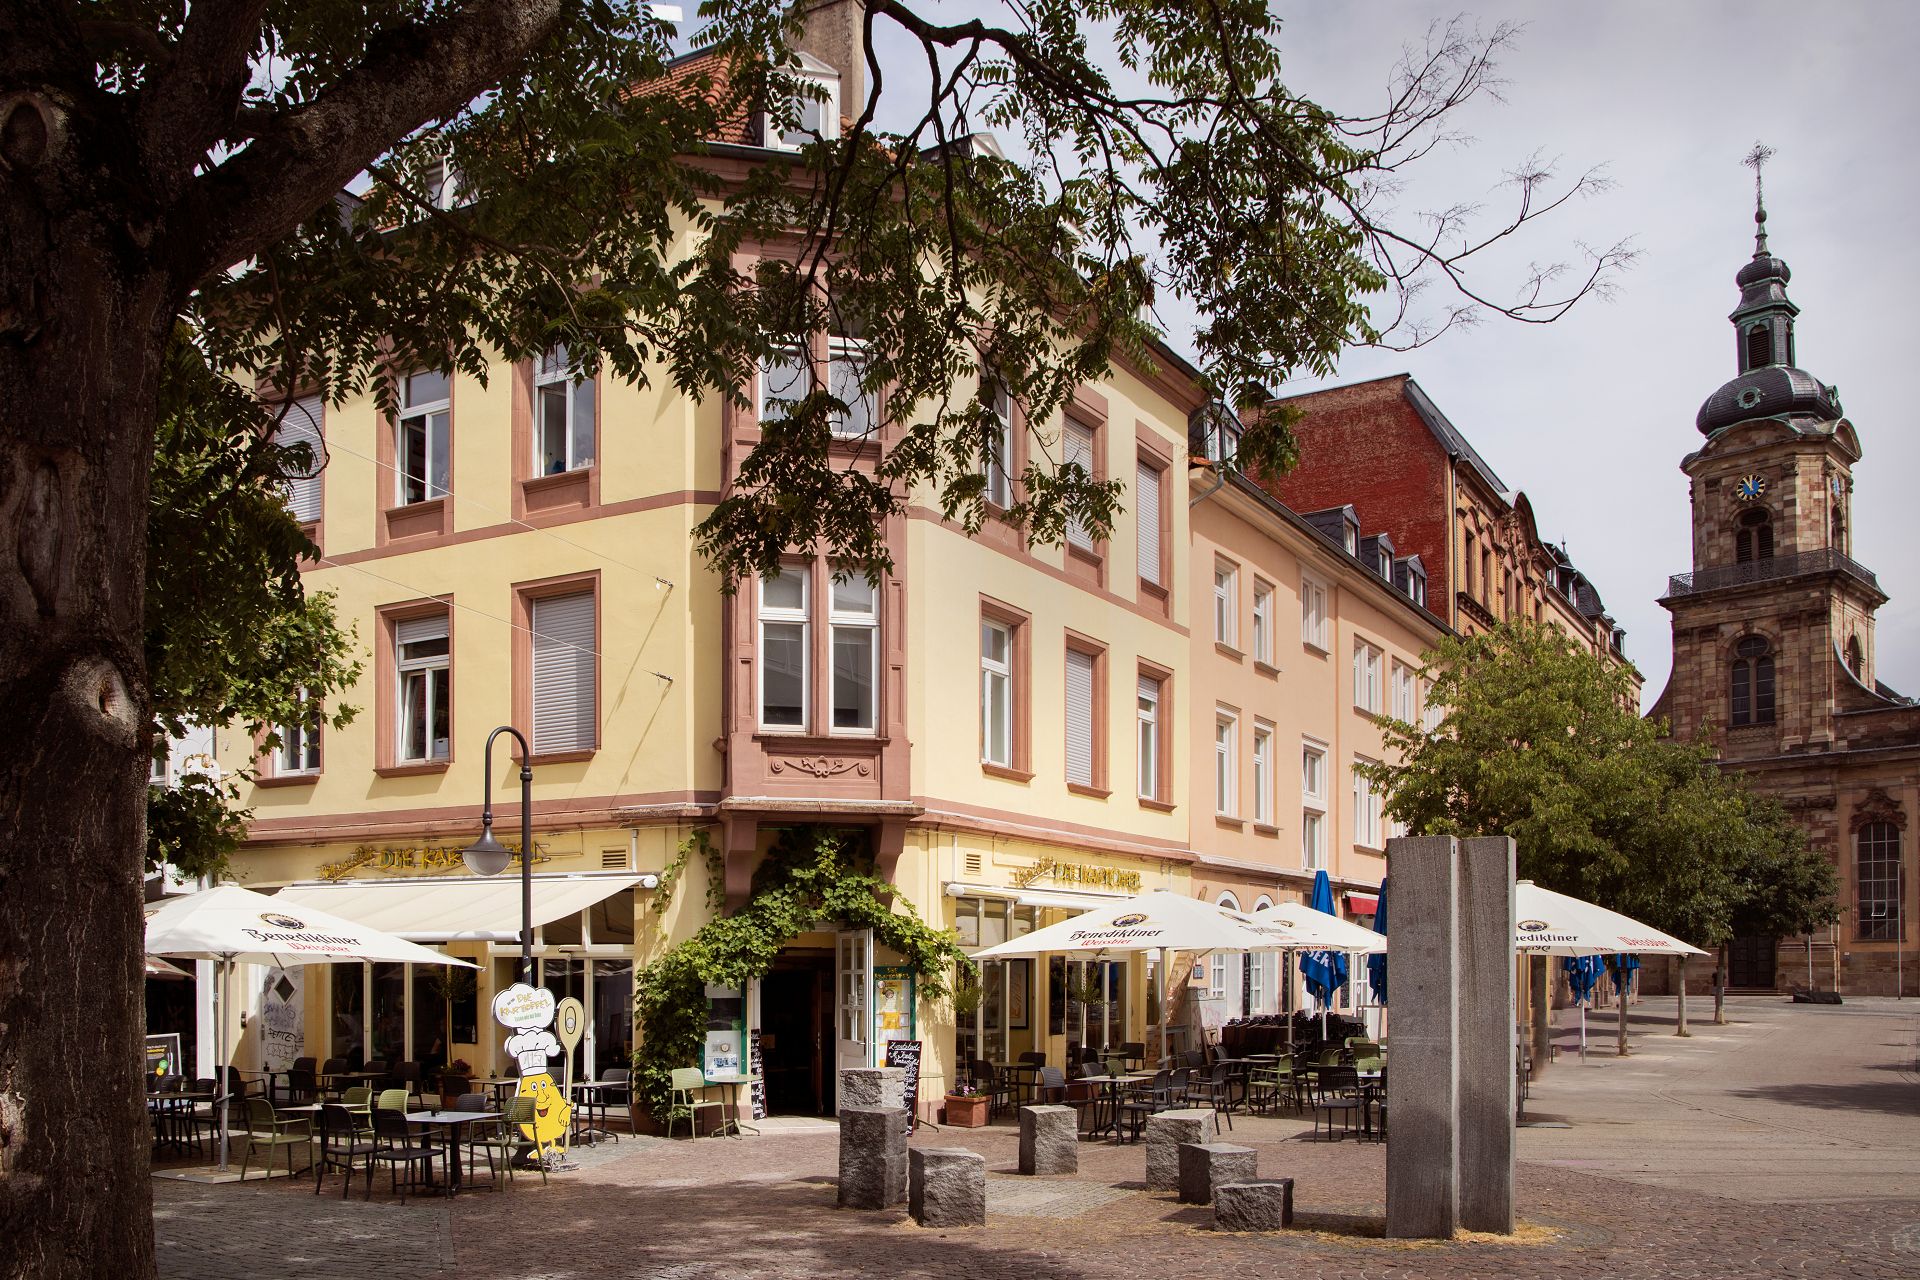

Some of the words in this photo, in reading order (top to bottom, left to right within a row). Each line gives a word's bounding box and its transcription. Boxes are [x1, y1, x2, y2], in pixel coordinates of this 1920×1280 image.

[379, 847, 416, 870] DIE
[241, 928, 362, 946] Benediktiner
[1068, 929, 1166, 942] Benediktiner
[1515, 934, 1579, 942] ediktiner
[1081, 938, 1133, 947] Weissbier
[516, 992, 533, 1002] DIE
[499, 998, 552, 1017] KARTOFFEL
